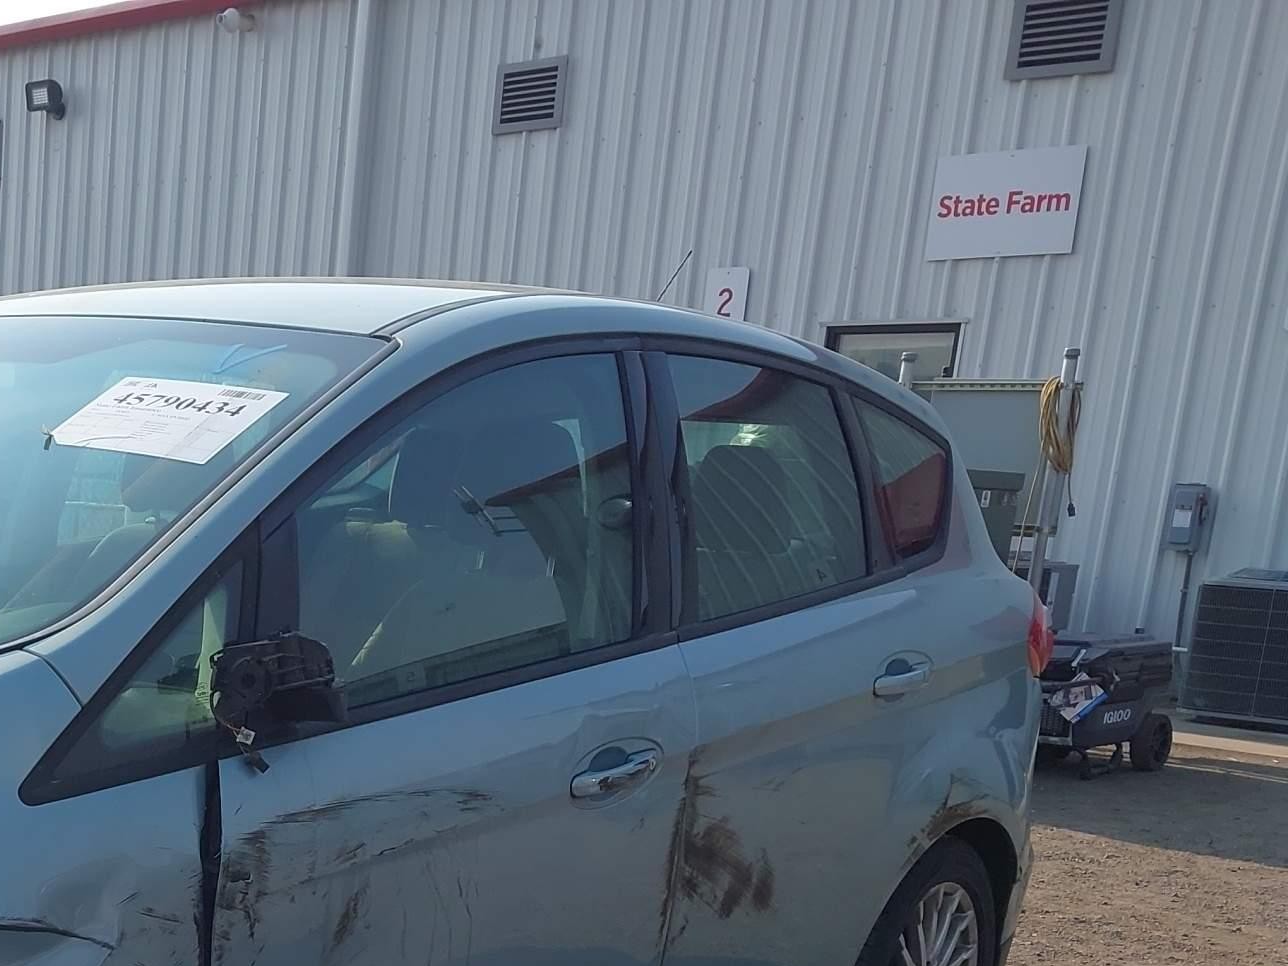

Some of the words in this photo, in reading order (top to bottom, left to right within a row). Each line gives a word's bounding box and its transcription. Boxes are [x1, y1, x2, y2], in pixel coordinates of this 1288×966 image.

[937, 193, 1000, 219] State
[1006, 190, 1071, 214] Farm
[716, 287, 733, 318] 2
[113, 392, 247, 418] 45790434
[1103, 708, 1131, 724] IGLOO
